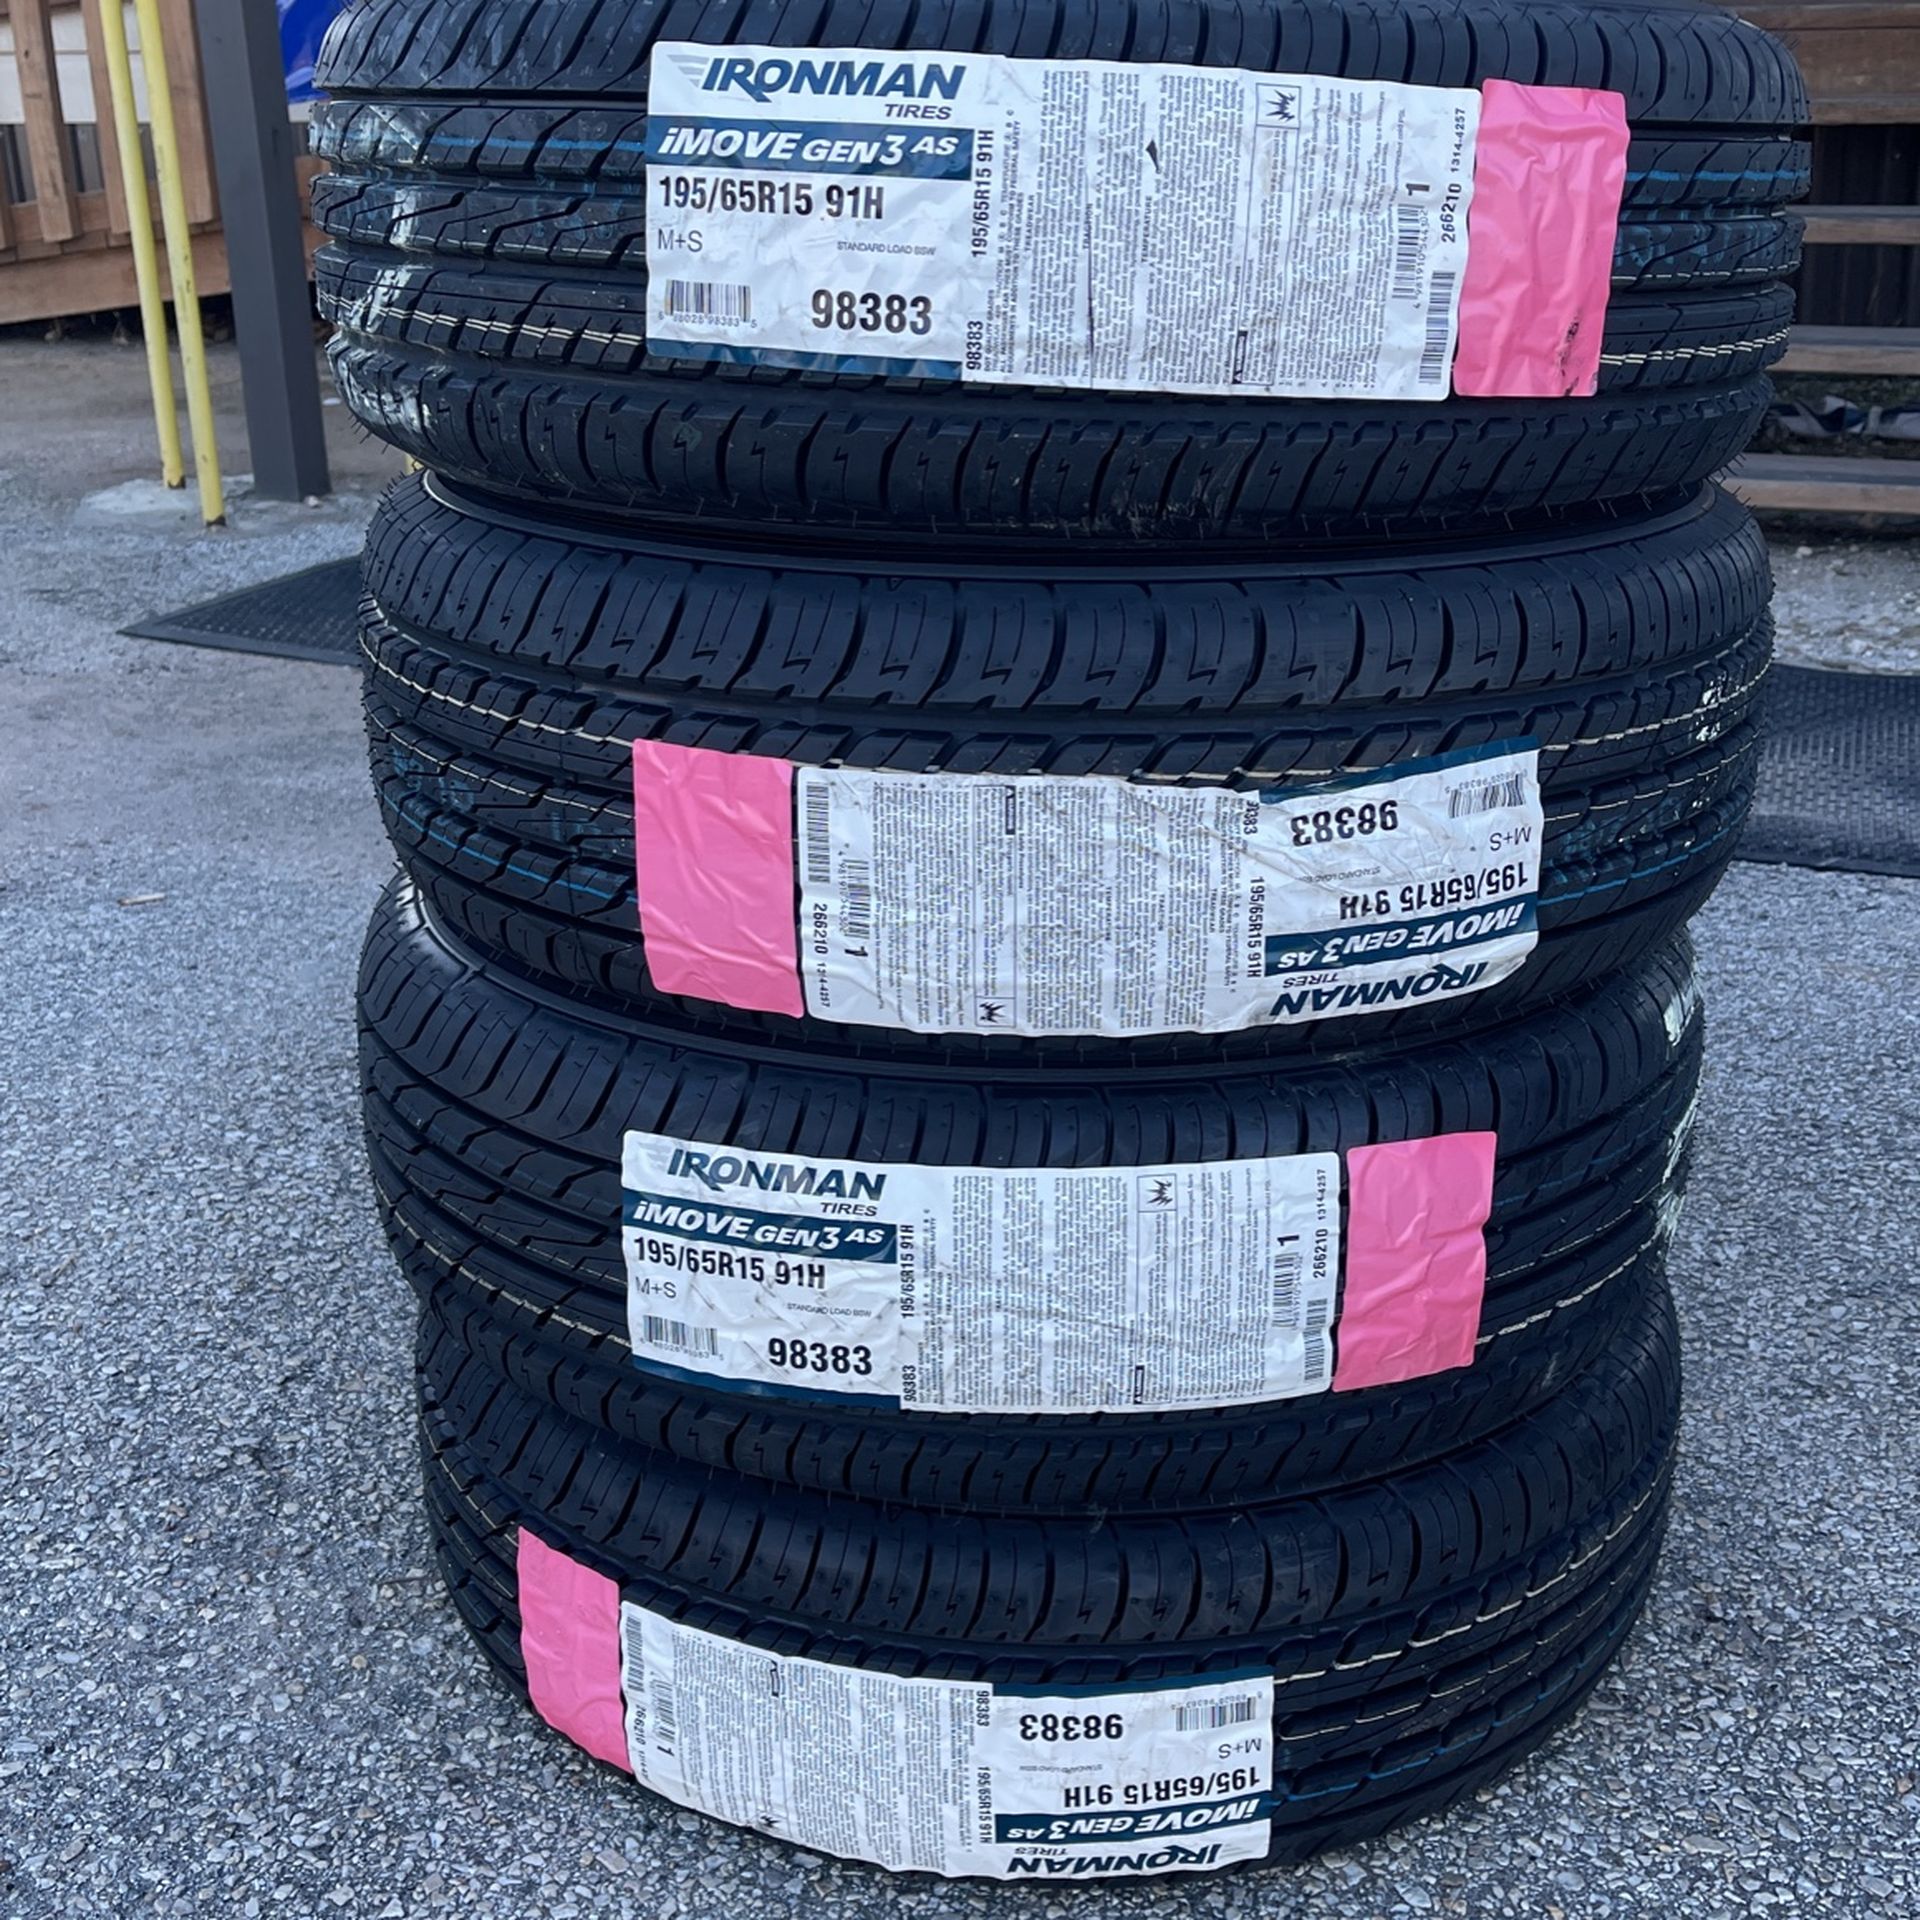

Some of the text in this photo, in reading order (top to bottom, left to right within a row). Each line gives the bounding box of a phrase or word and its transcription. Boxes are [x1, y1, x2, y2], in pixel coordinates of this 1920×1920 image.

[702, 57, 966, 103] IRONMAN
[884, 103, 952, 120] TIRES
[658, 127, 803, 160] iMOVE
[909, 135, 960, 156] AS
[1405, 183, 1431, 196] 1
[1440, 107, 1466, 243] 266210 1314-4257
[659, 175, 885, 220] 195/65R15 91H
[657, 228, 704, 253] M+S
[1024, 194, 1034, 252] TREADWEAR
[1140, 195, 1153, 264] TEMPERATURE
[837, 240, 887, 254] STANDARD
[886, 243, 913, 255] LOAD
[966, 129, 994, 371] 98383 195/65R15 91H
[810, 288, 933, 336] 98383
[1290, 799, 1399, 847] 98383
[1489, 825, 1533, 852] M+S
[1340, 860, 1529, 920] 195/65R15 91H
[813, 902, 829, 954] 266210
[1247, 876, 1265, 948] 195/65R15
[1407, 901, 1527, 951] iMOVE
[844, 945, 869, 957] 1
[1247, 952, 1262, 978] 91H
[1276, 949, 1319, 970] AS
[1269, 961, 1490, 1017] IRONMAN
[1282, 971, 1340, 989] TIRES
[666, 1148, 887, 1201] IRONMAN
[632, 1199, 753, 1239] iMOVE
[843, 1227, 885, 1244] AS
[820, 1201, 878, 1217] TIRES
[900, 1224, 914, 1250] 91H
[1278, 1233, 1300, 1246] 1
[1312, 1229, 1328, 1279] 266210
[633, 1236, 826, 1289] 195/65R15 91H
[634, 1276, 677, 1299] M+S
[900, 1253, 915, 1319] 195/65R15
[767, 1337, 873, 1376] 98383
[633, 1703, 647, 1746] 266210
[1019, 1713, 1124, 1741] 98383
[656, 1744, 675, 1757] 1
[1217, 1737, 1263, 1759] M+S
[976, 1766, 993, 1821] 195/65R15
[1063, 1766, 1261, 1808] 195/65R15 91H
[978, 1823, 993, 1844] 91H
[1006, 1826, 1045, 1840] AS
[1134, 1798, 1261, 1834] iMOVE
[1006, 1843, 1222, 1876] IRONMAN
[1014, 1846, 1068, 1857] TIRES
